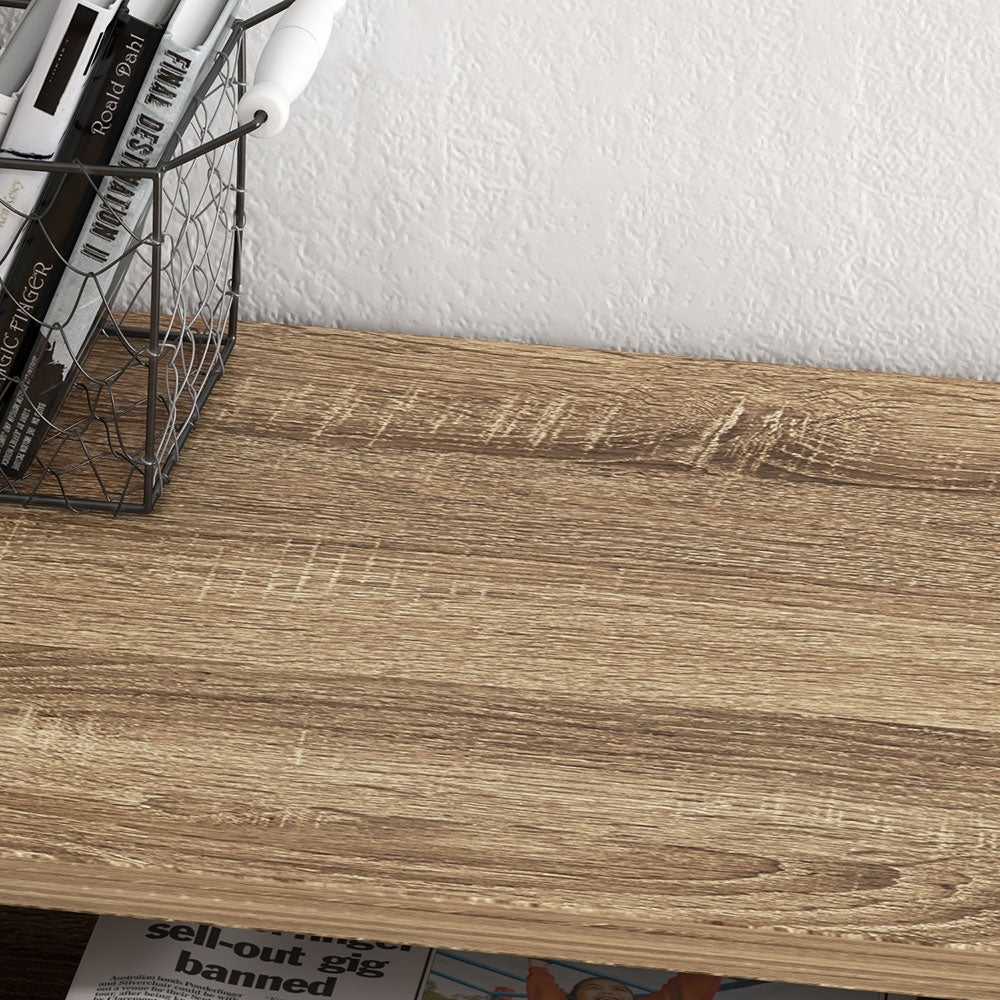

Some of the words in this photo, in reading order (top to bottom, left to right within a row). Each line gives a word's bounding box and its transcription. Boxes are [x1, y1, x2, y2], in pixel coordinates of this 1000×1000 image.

[92, 80, 125, 136] Roald
[115, 33, 145, 77] Dahl
[144, 48, 192, 109] FINAL
[10, 261, 54, 333] FINGER
[144, 922, 306, 967] sell-out
[317, 953, 391, 978] gig
[174, 949, 338, 998] banned
